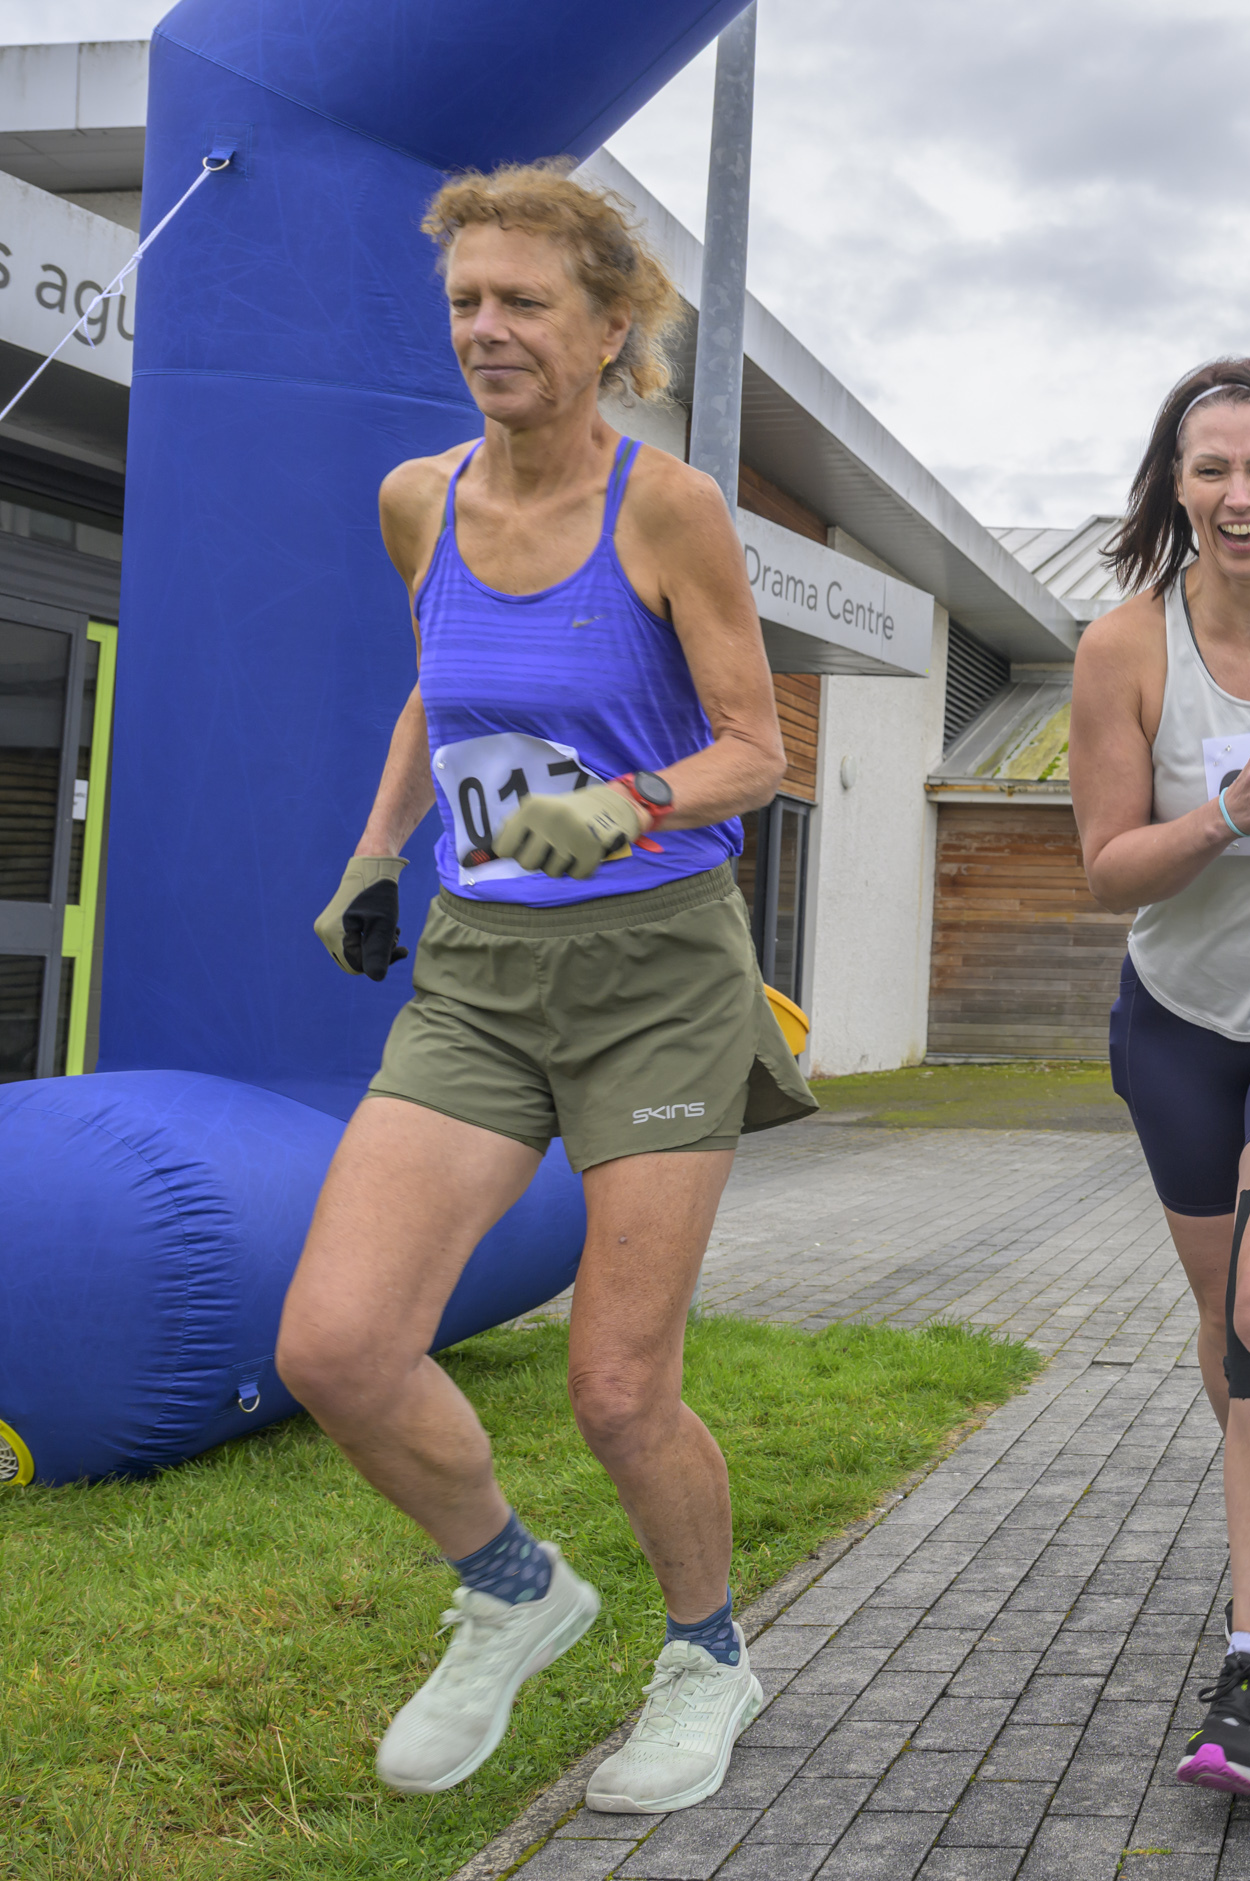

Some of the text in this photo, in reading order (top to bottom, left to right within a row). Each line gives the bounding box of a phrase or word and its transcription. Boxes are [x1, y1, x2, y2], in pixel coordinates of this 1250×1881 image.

[744, 543, 894, 640] Drama Centre
[632, 1102, 705, 1125] SKINS
